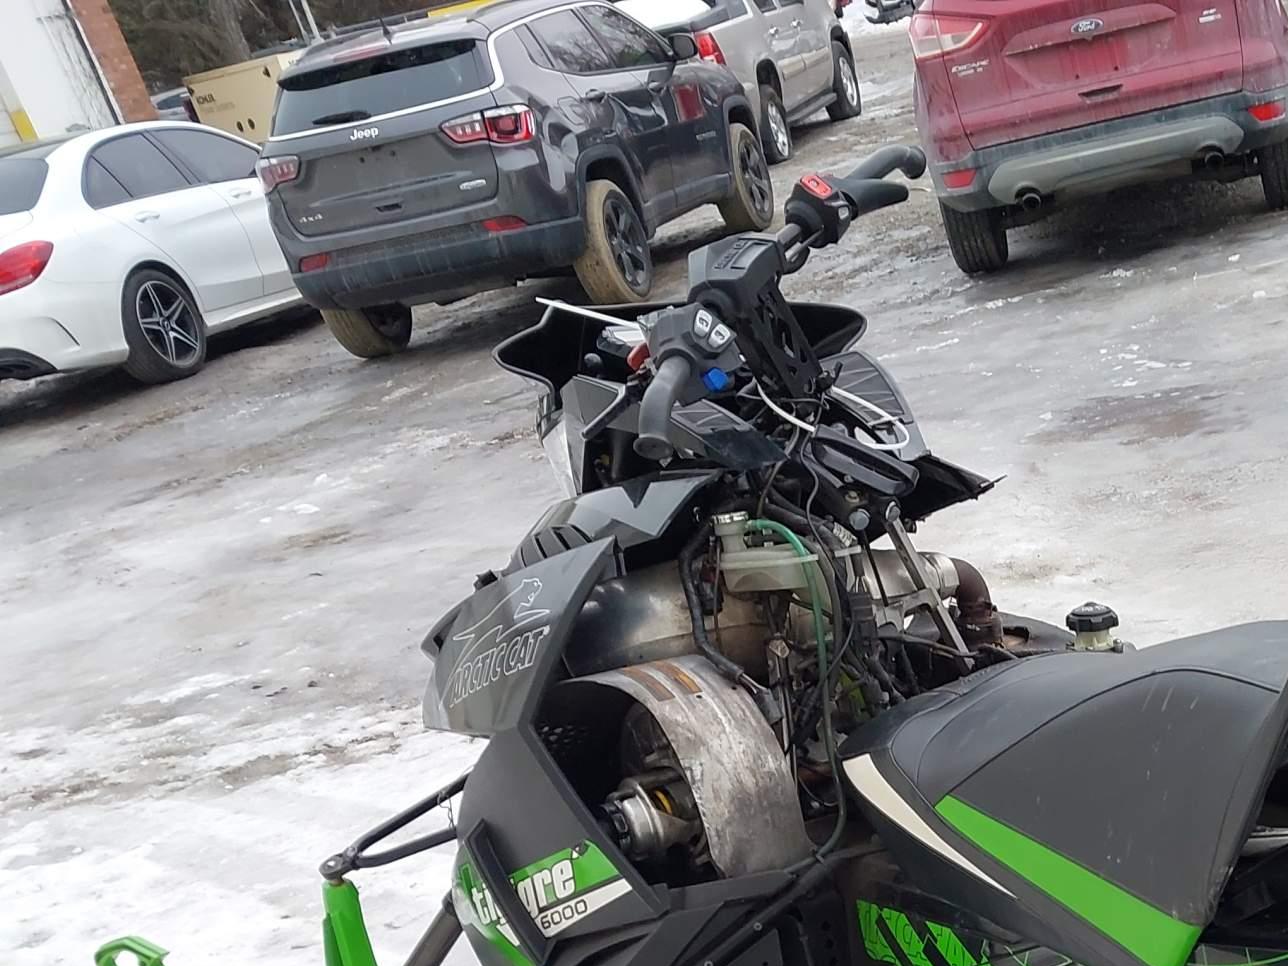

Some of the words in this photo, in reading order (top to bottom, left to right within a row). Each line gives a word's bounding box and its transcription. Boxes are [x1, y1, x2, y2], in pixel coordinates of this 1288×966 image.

[350, 127, 379, 140] Jeep
[449, 643, 507, 708] ARCTIC
[540, 899, 588, 930] 6000
